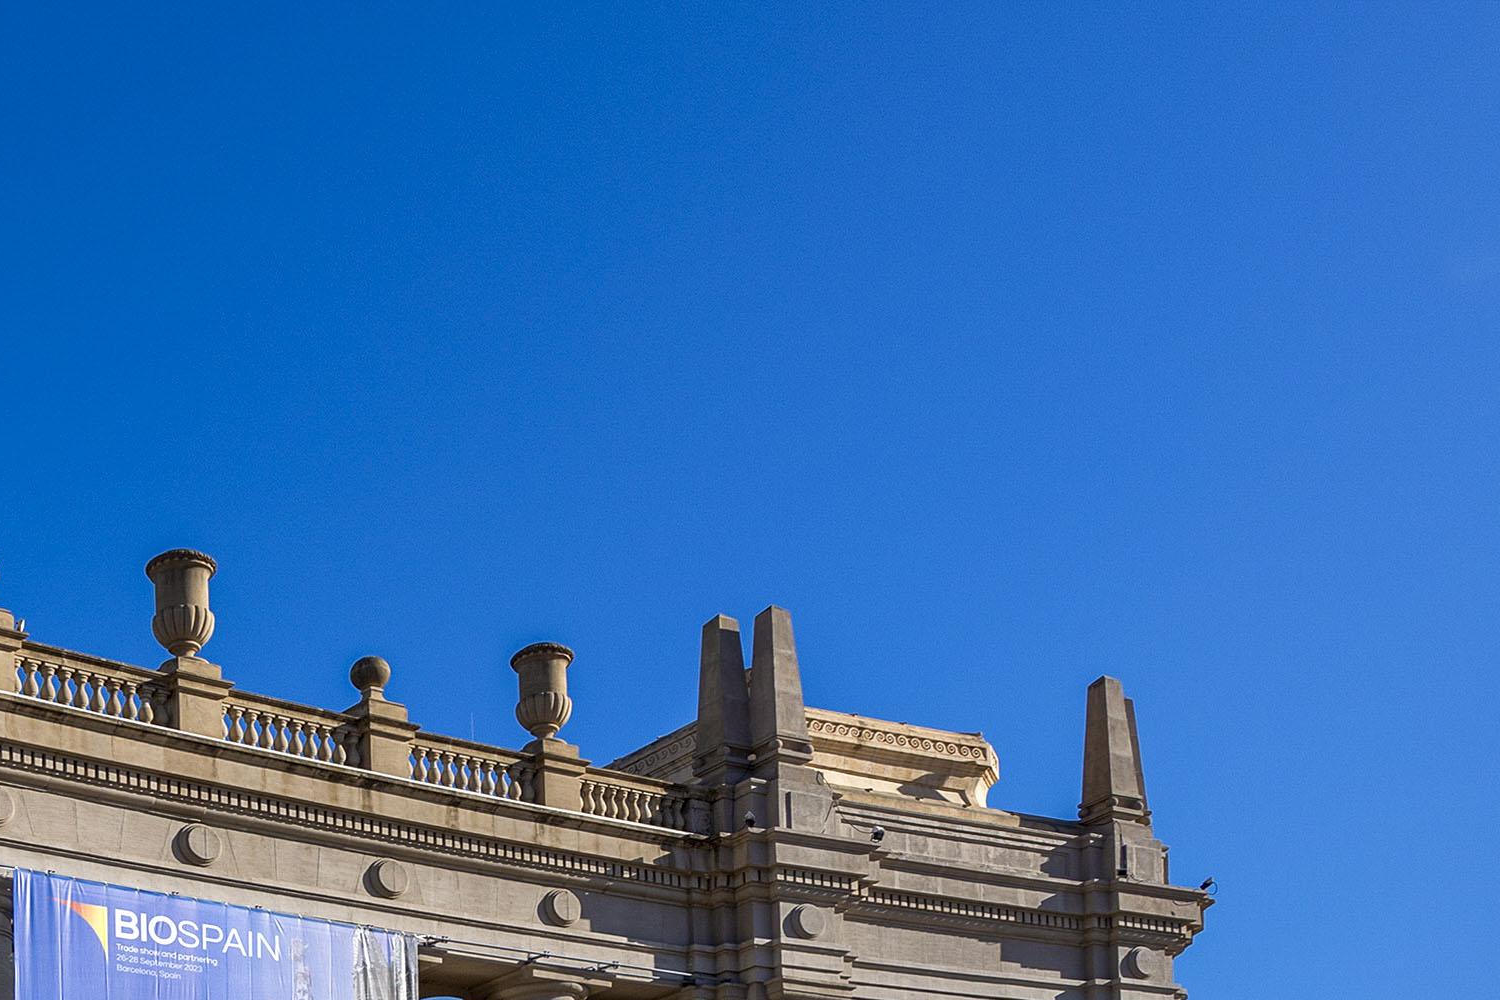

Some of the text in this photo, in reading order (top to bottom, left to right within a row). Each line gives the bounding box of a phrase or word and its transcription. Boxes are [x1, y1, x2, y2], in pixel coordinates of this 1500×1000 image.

[114, 908, 280, 962] BIOSPAIN
[116, 943, 218, 966] Trade show and partnering
[116, 954, 203, 973] 26-28 September 2023
[116, 964, 182, 980] Barcelona, Spain
